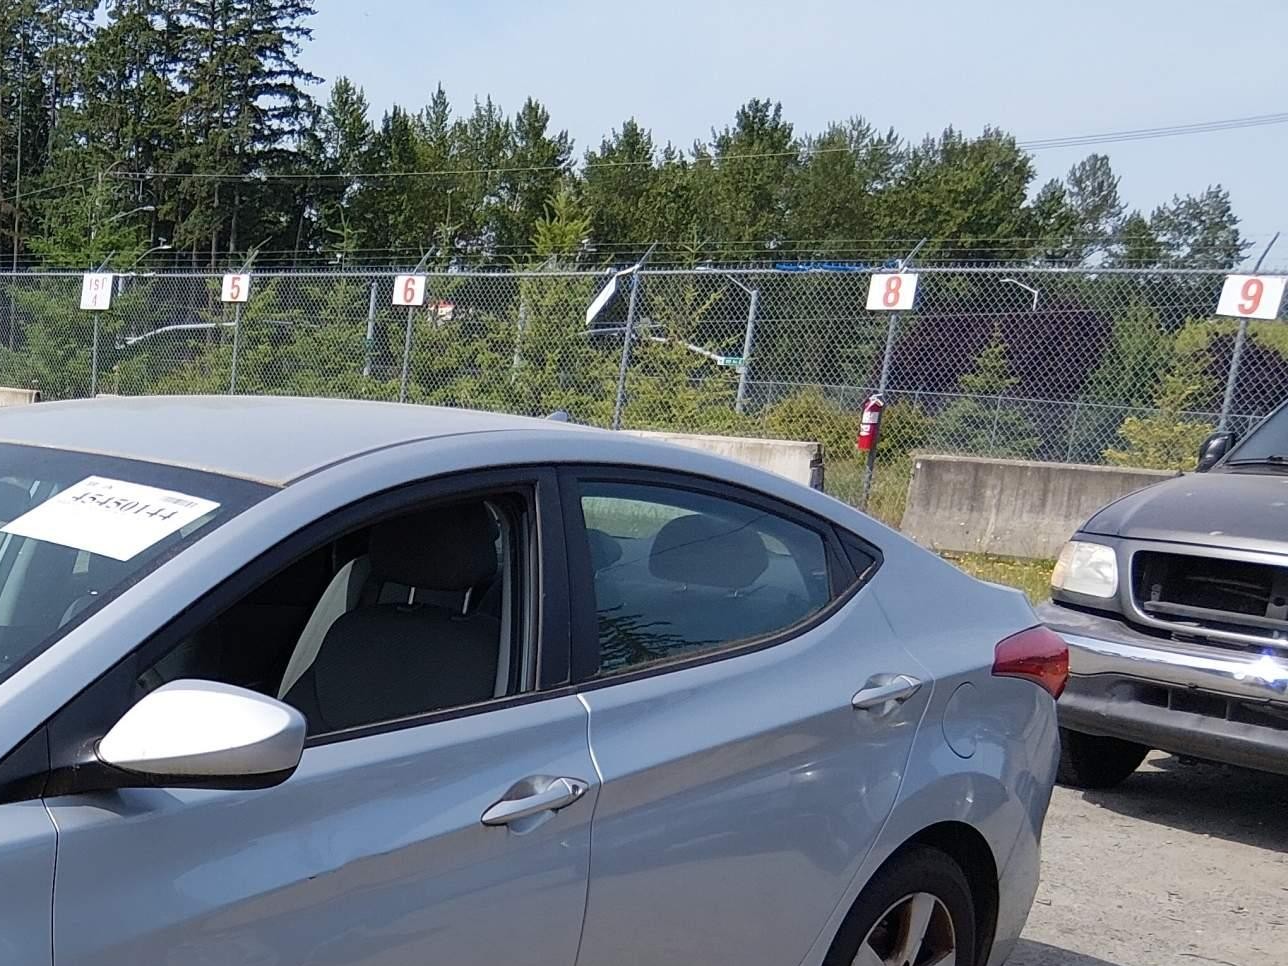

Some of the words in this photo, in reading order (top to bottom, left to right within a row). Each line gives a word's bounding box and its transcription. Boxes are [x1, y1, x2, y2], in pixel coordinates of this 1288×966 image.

[231, 276, 241, 300] 5
[403, 277, 416, 303] 6
[882, 276, 902, 307] 8
[1238, 278, 1264, 315] 9
